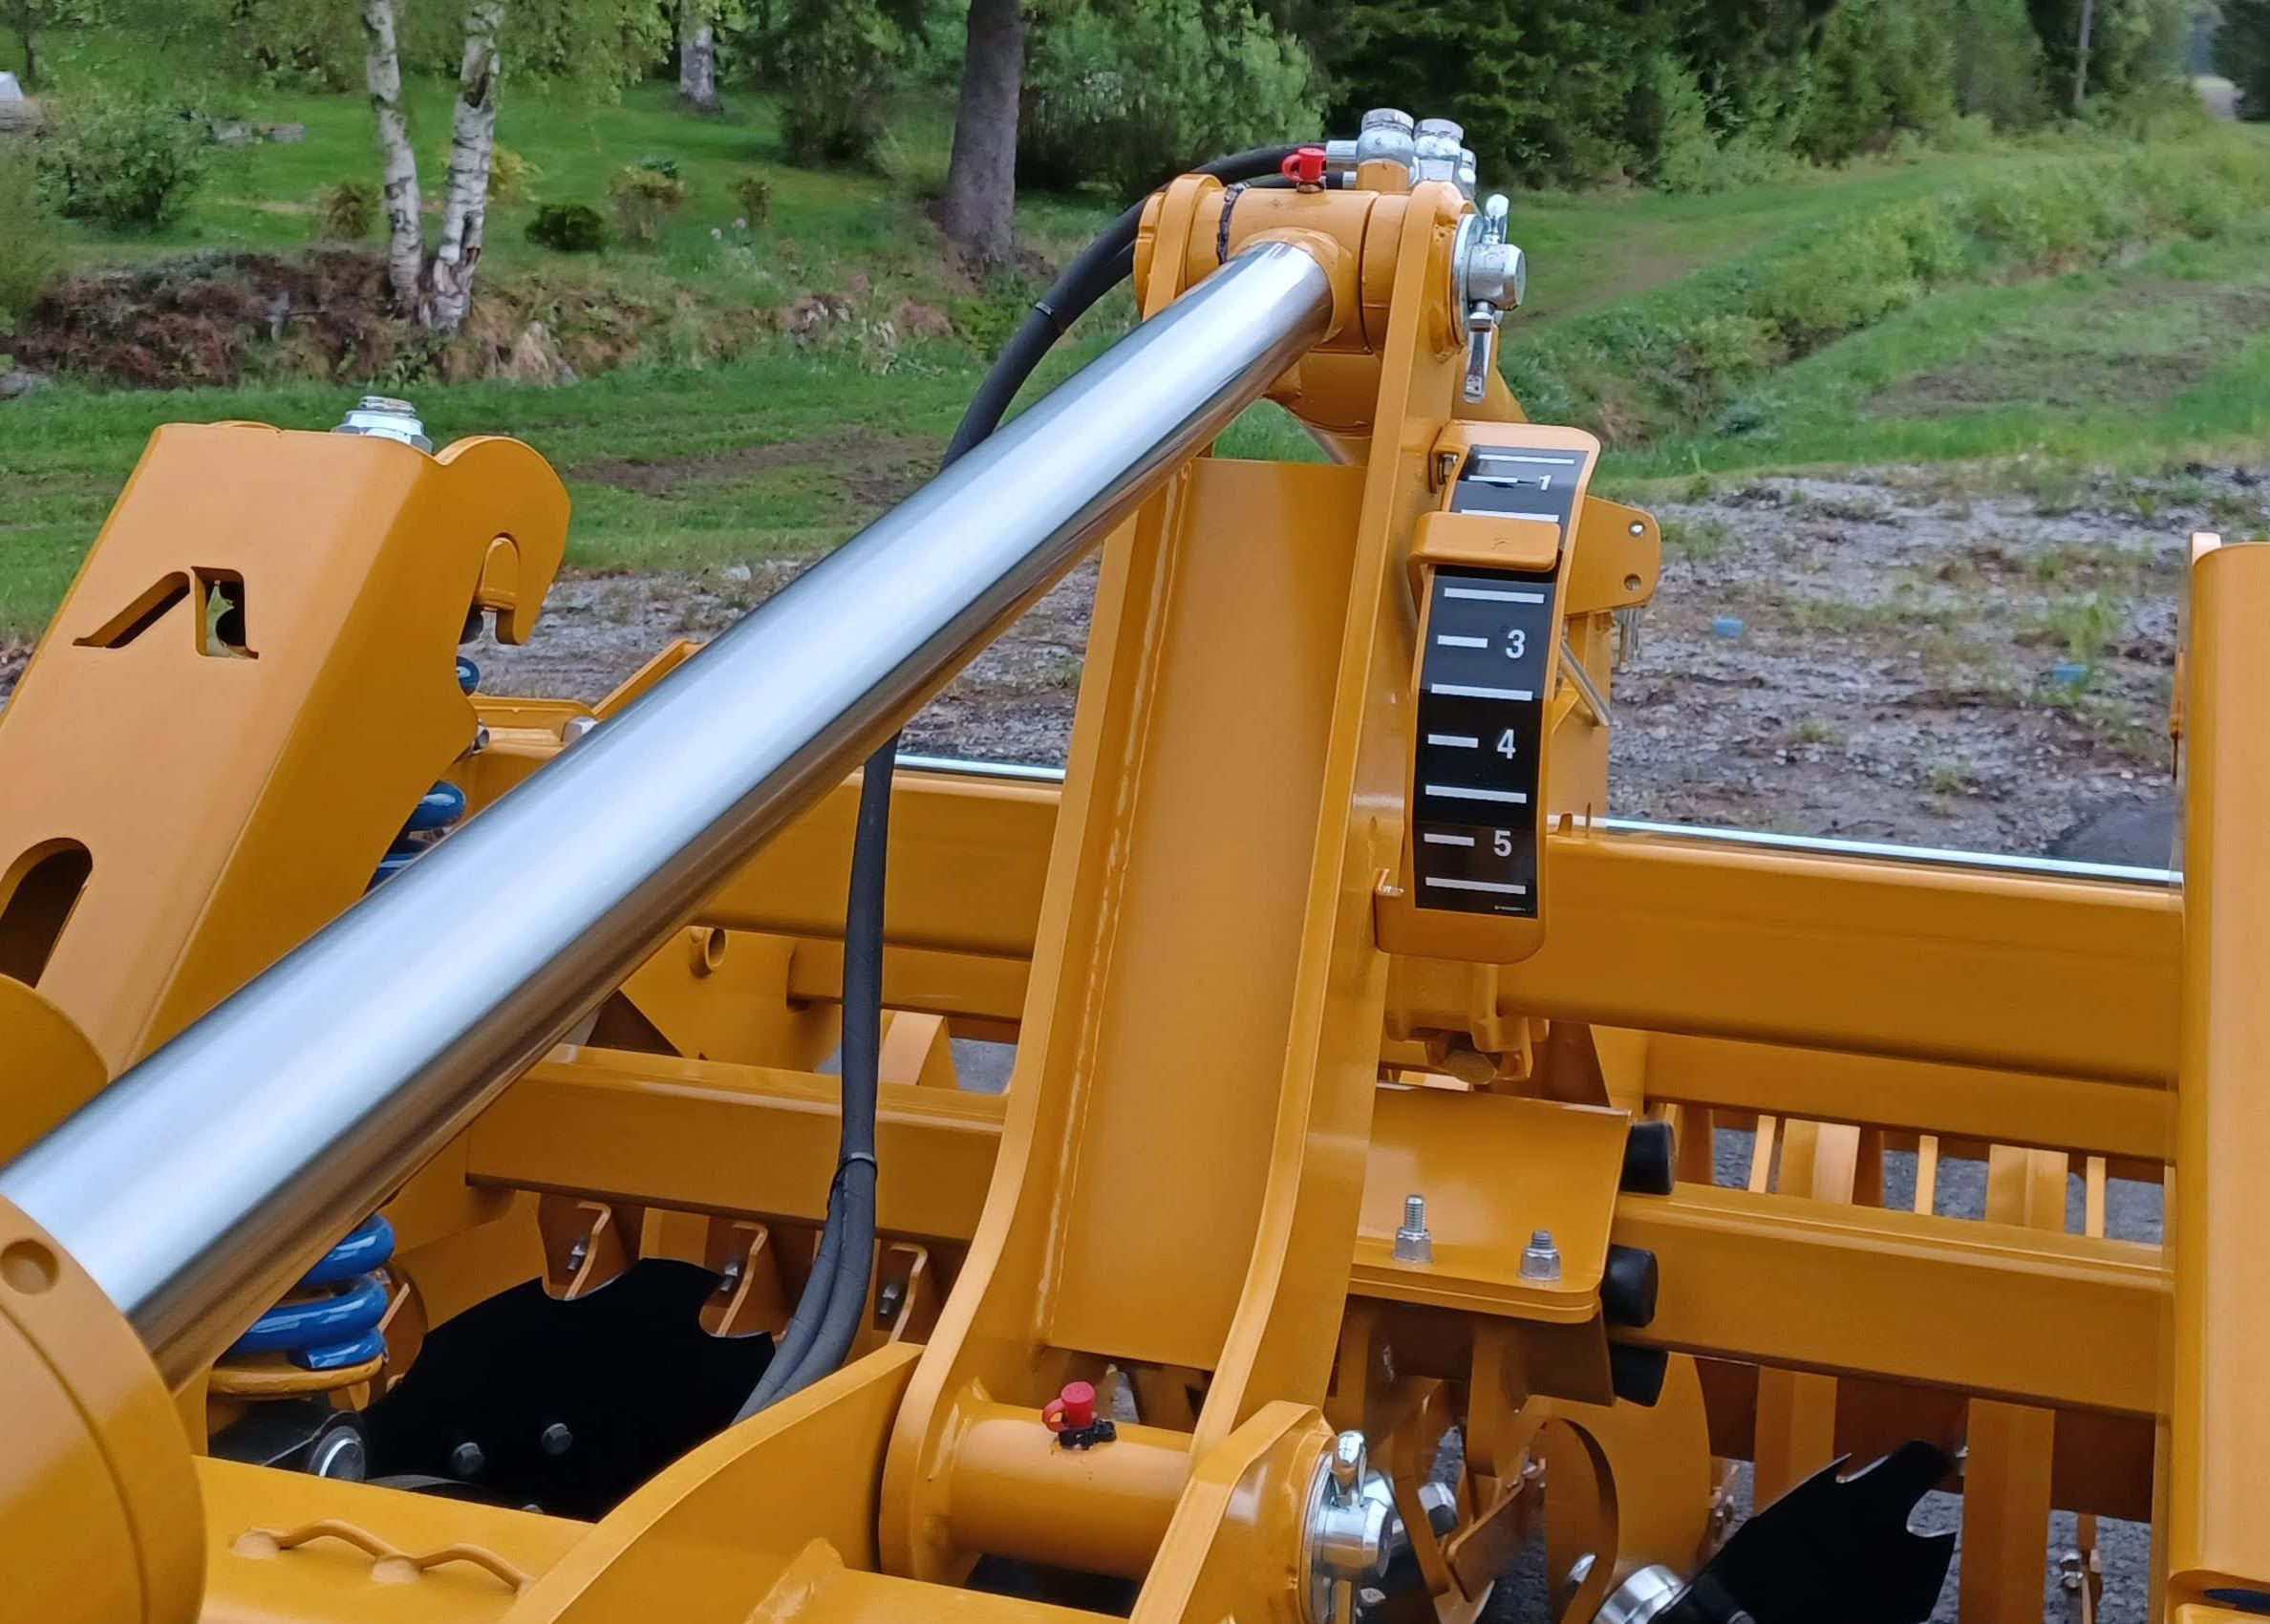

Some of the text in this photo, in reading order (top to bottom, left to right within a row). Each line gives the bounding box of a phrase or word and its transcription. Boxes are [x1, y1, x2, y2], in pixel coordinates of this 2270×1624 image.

[1539, 474, 1553, 491] 1
[1505, 629, 1526, 659] 3
[1496, 728, 1517, 759] 4
[1493, 829, 1512, 857] 5
